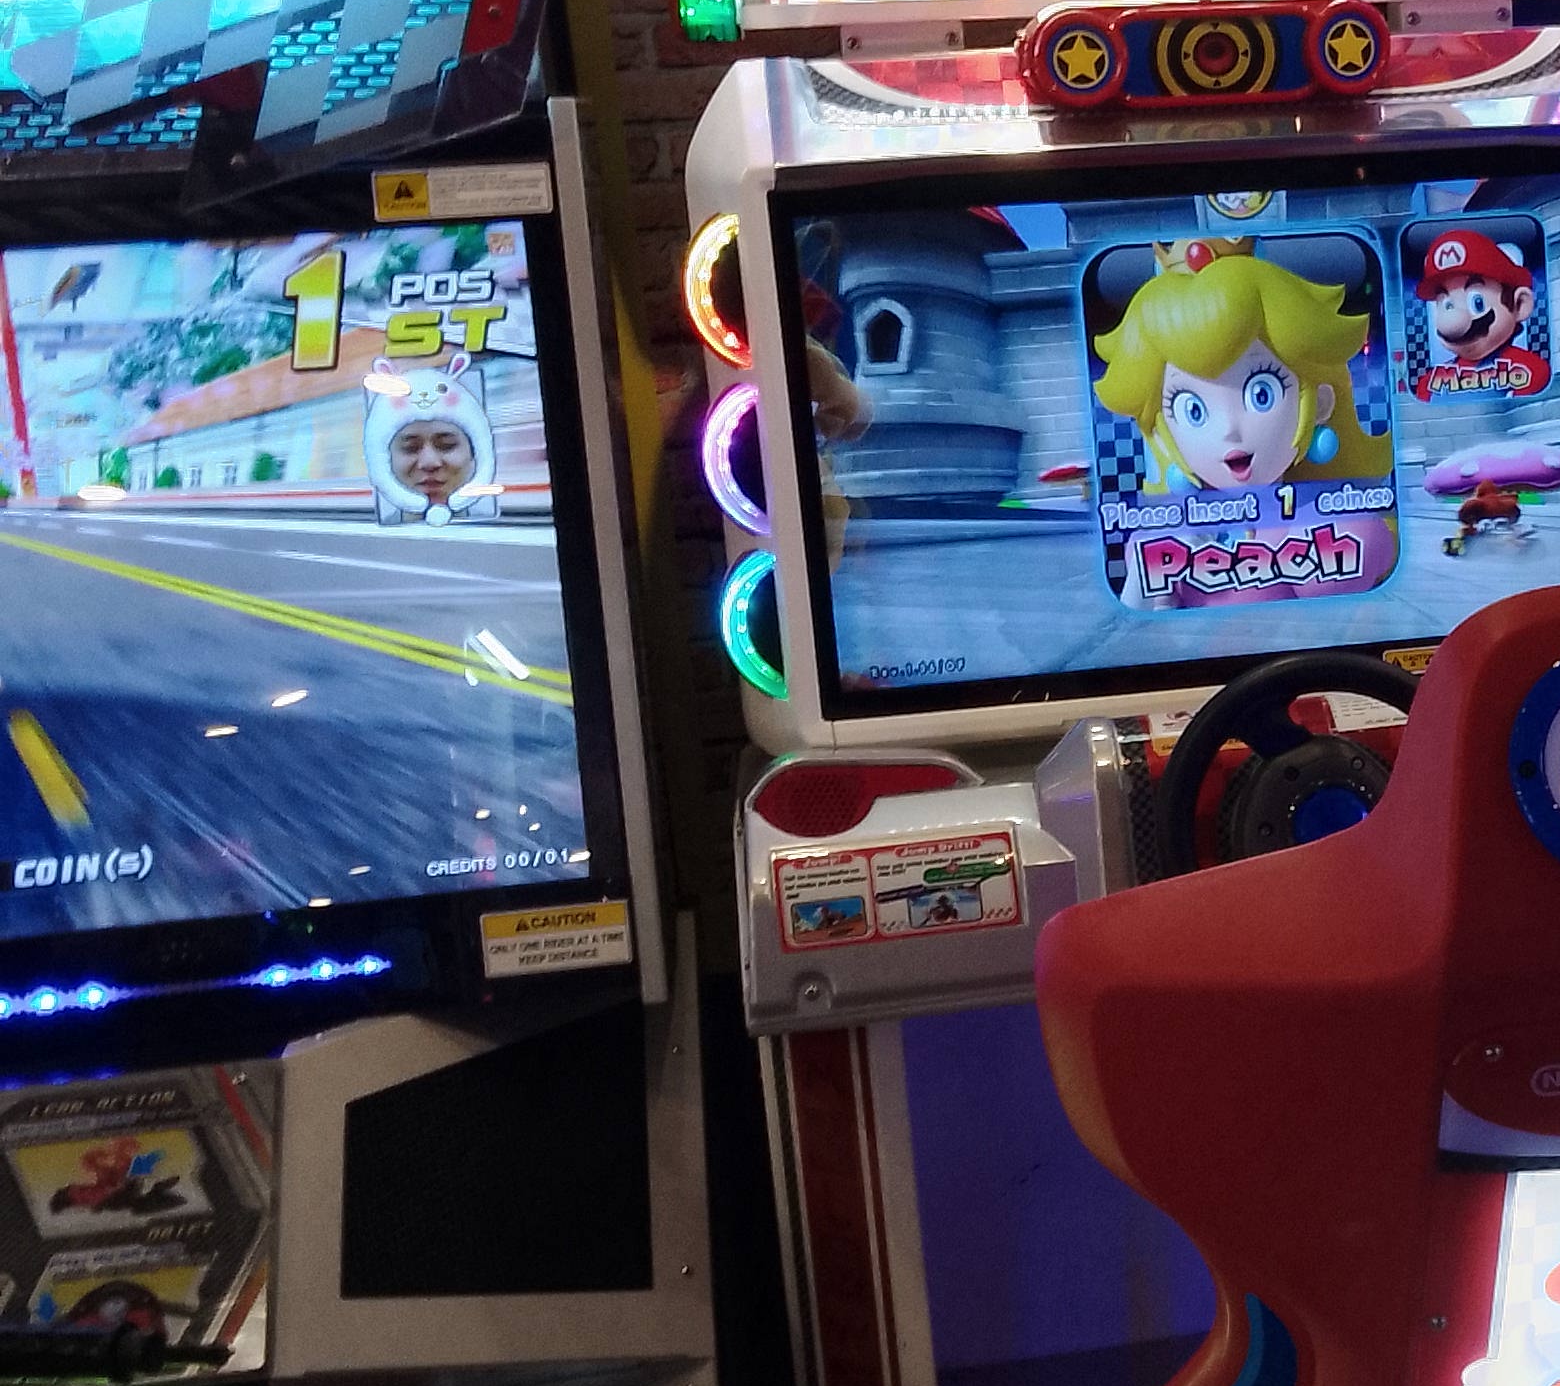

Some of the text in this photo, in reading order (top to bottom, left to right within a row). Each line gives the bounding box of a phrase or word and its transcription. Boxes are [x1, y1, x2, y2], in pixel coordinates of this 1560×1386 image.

[389, 269, 498, 305] POS
[284, 251, 345, 371] 1
[384, 306, 506, 358] ST
[1427, 359, 1532, 394] Mario
[1101, 483, 1393, 530] Please insert 1 coin(s)
[1138, 524, 1362, 597] Peach
[426, 855, 497, 877] CREDITS
[531, 911, 596, 930] CAUTION
